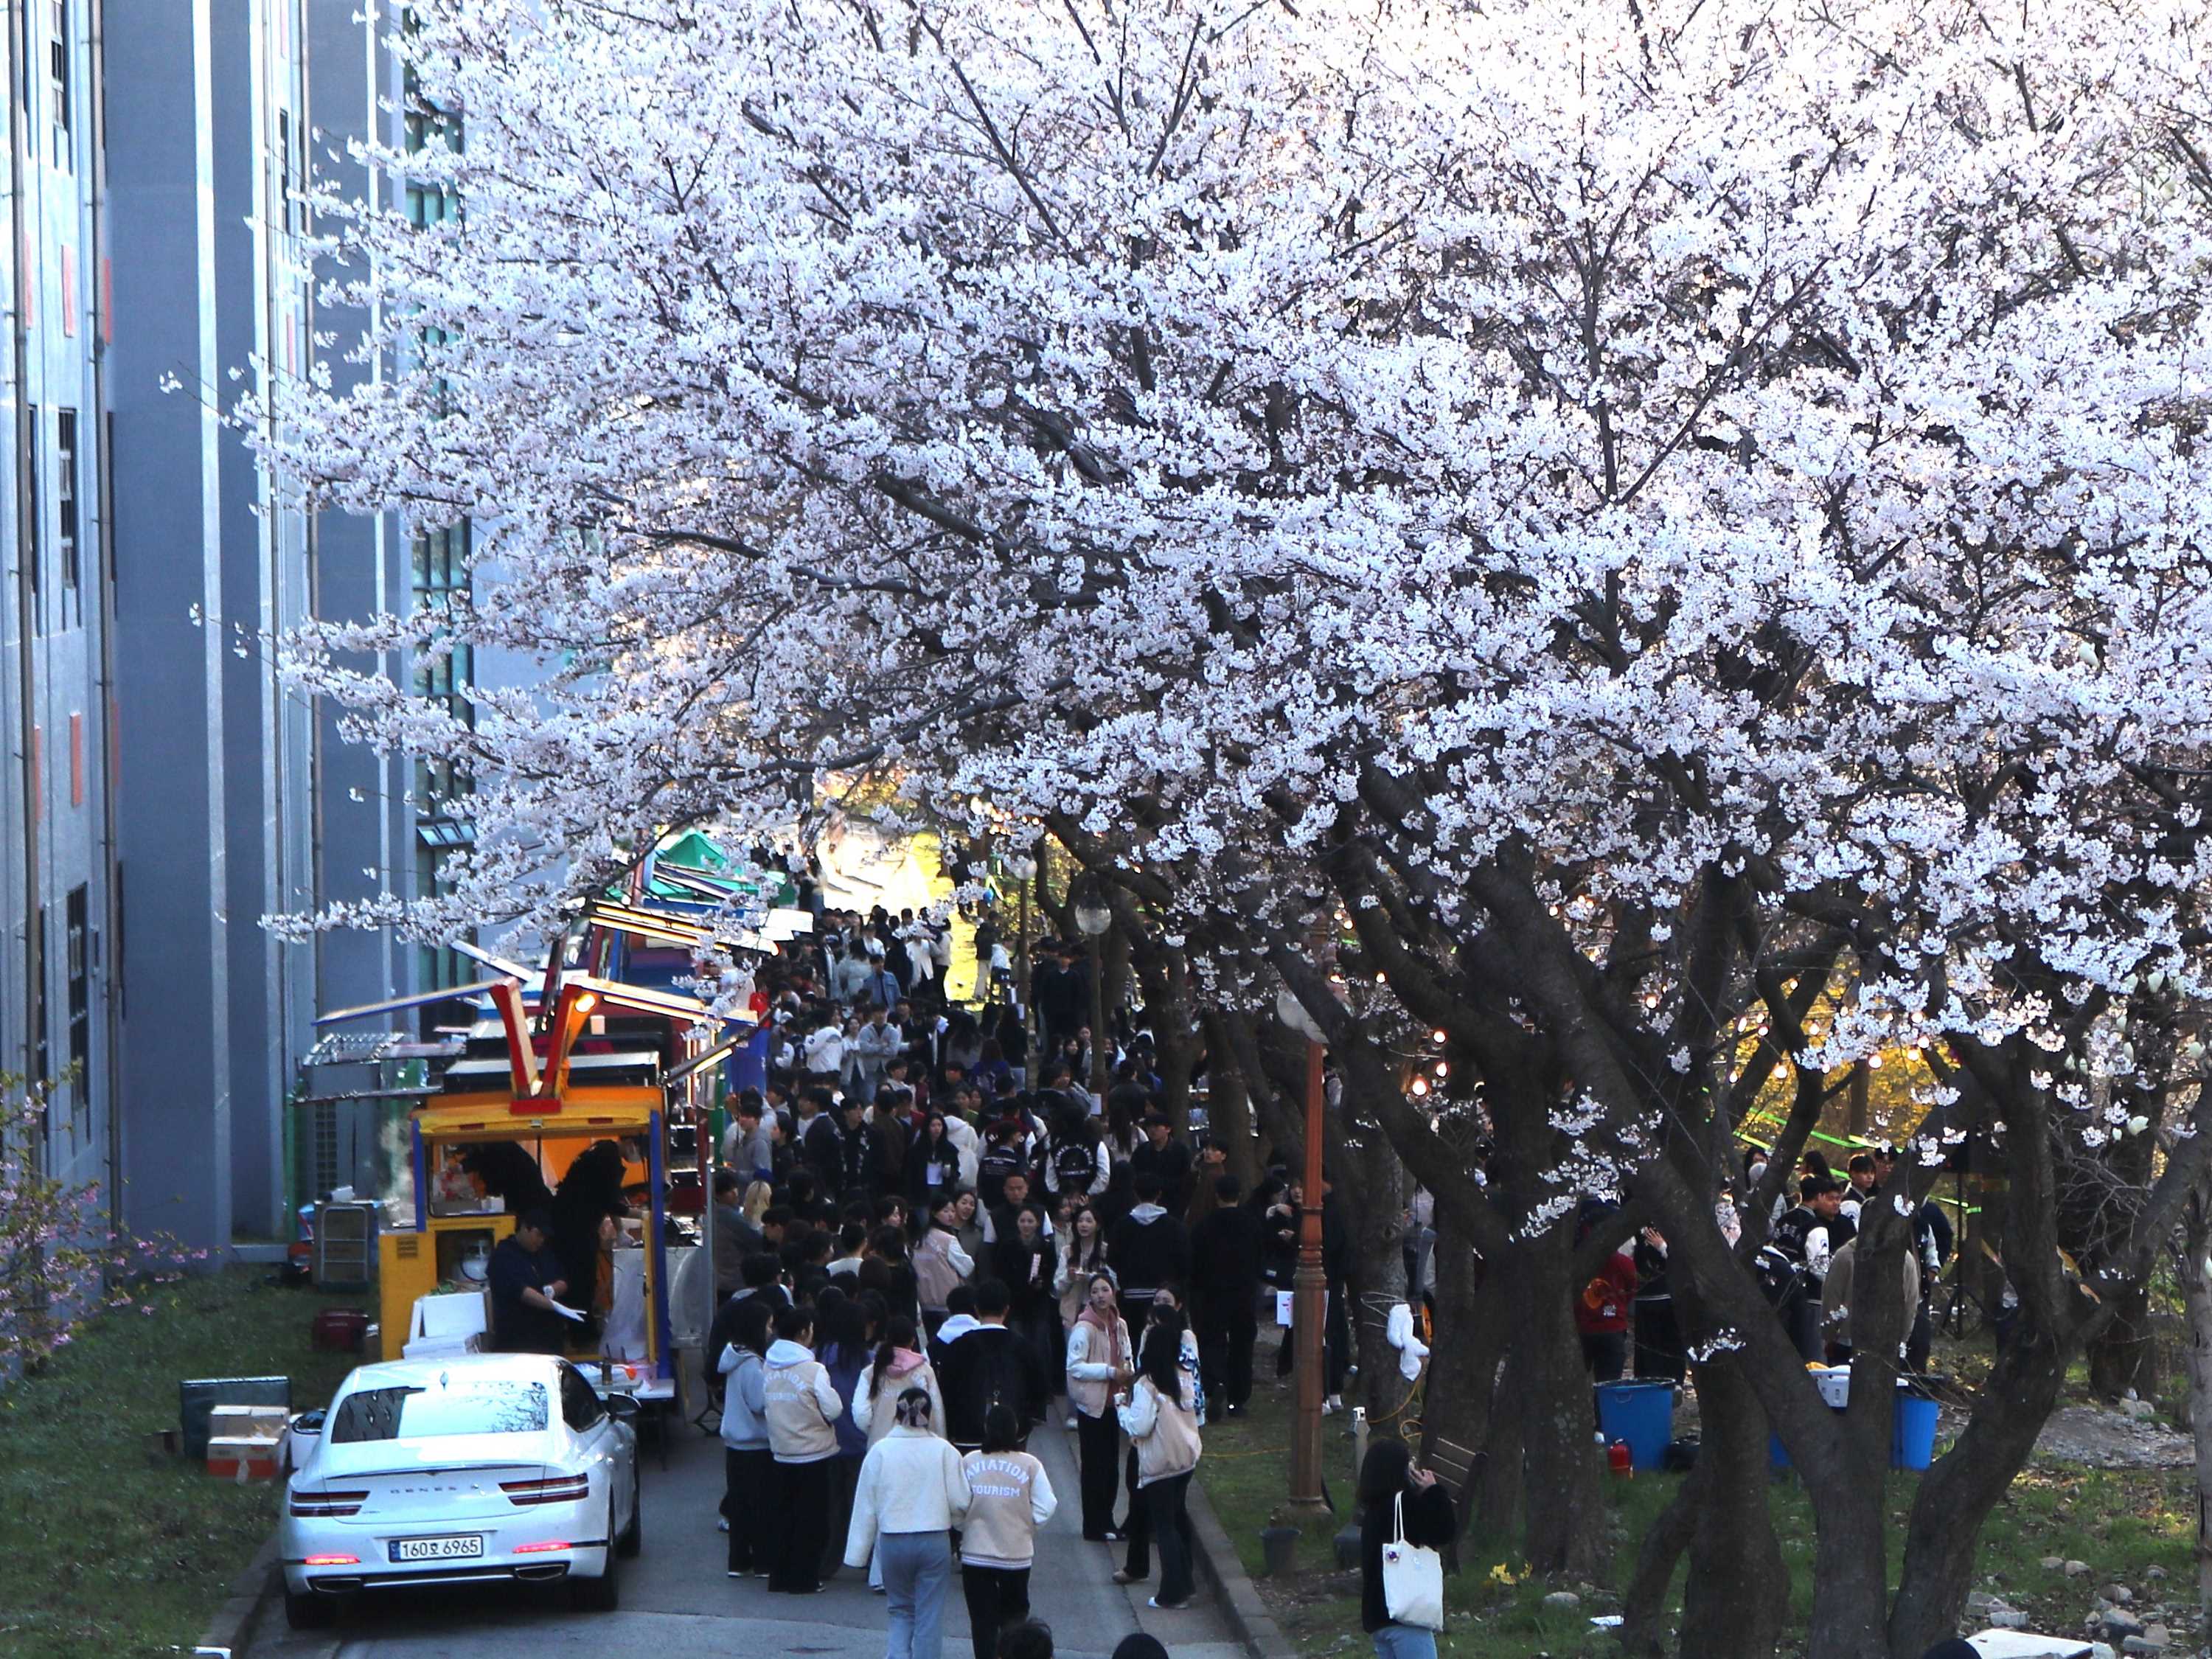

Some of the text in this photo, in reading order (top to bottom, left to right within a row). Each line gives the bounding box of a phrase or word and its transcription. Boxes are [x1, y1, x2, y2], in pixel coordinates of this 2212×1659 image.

[966, 1458, 1029, 1485] AVIATION
[390, 1484, 479, 1494] GENESS
[443, 1539, 479, 1555] 6965
